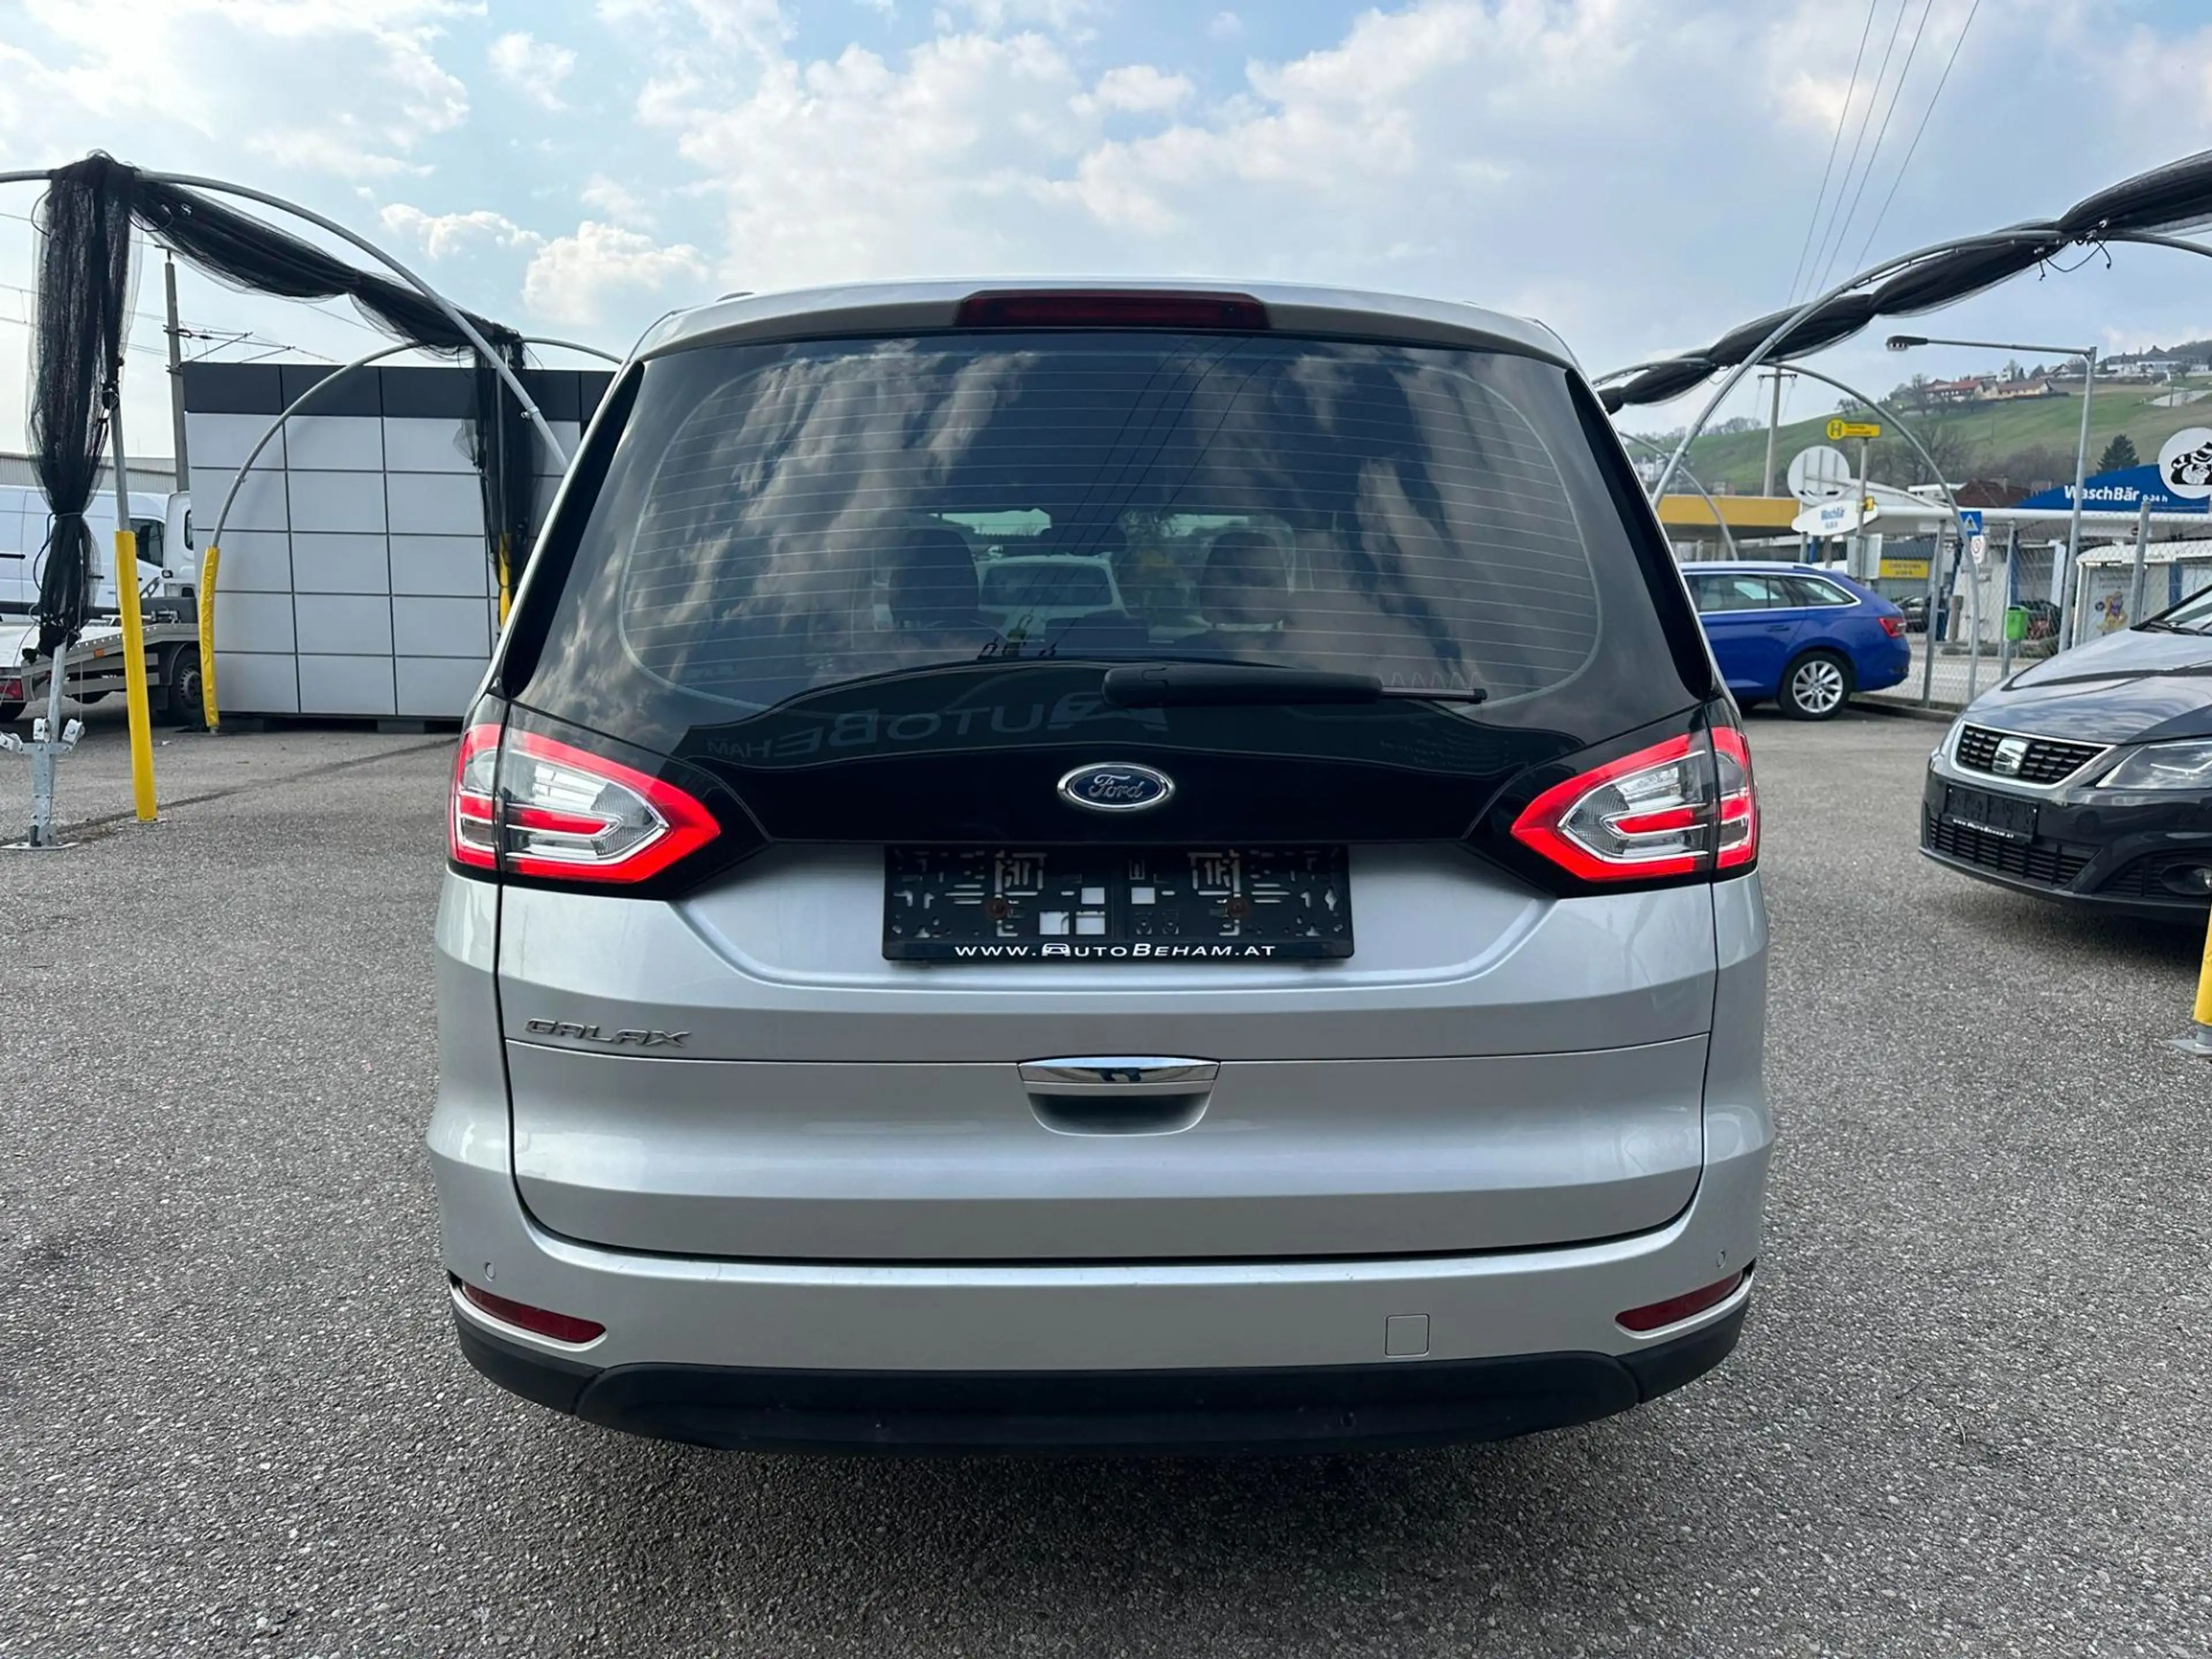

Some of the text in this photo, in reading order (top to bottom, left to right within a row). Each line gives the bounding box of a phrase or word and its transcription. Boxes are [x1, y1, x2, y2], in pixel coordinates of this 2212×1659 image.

[2064, 485, 2140, 502] WaschBär
[2161, 494, 2168, 503] h
[1088, 774, 1145, 798] Ford
[525, 1018, 691, 1047] GALAX
